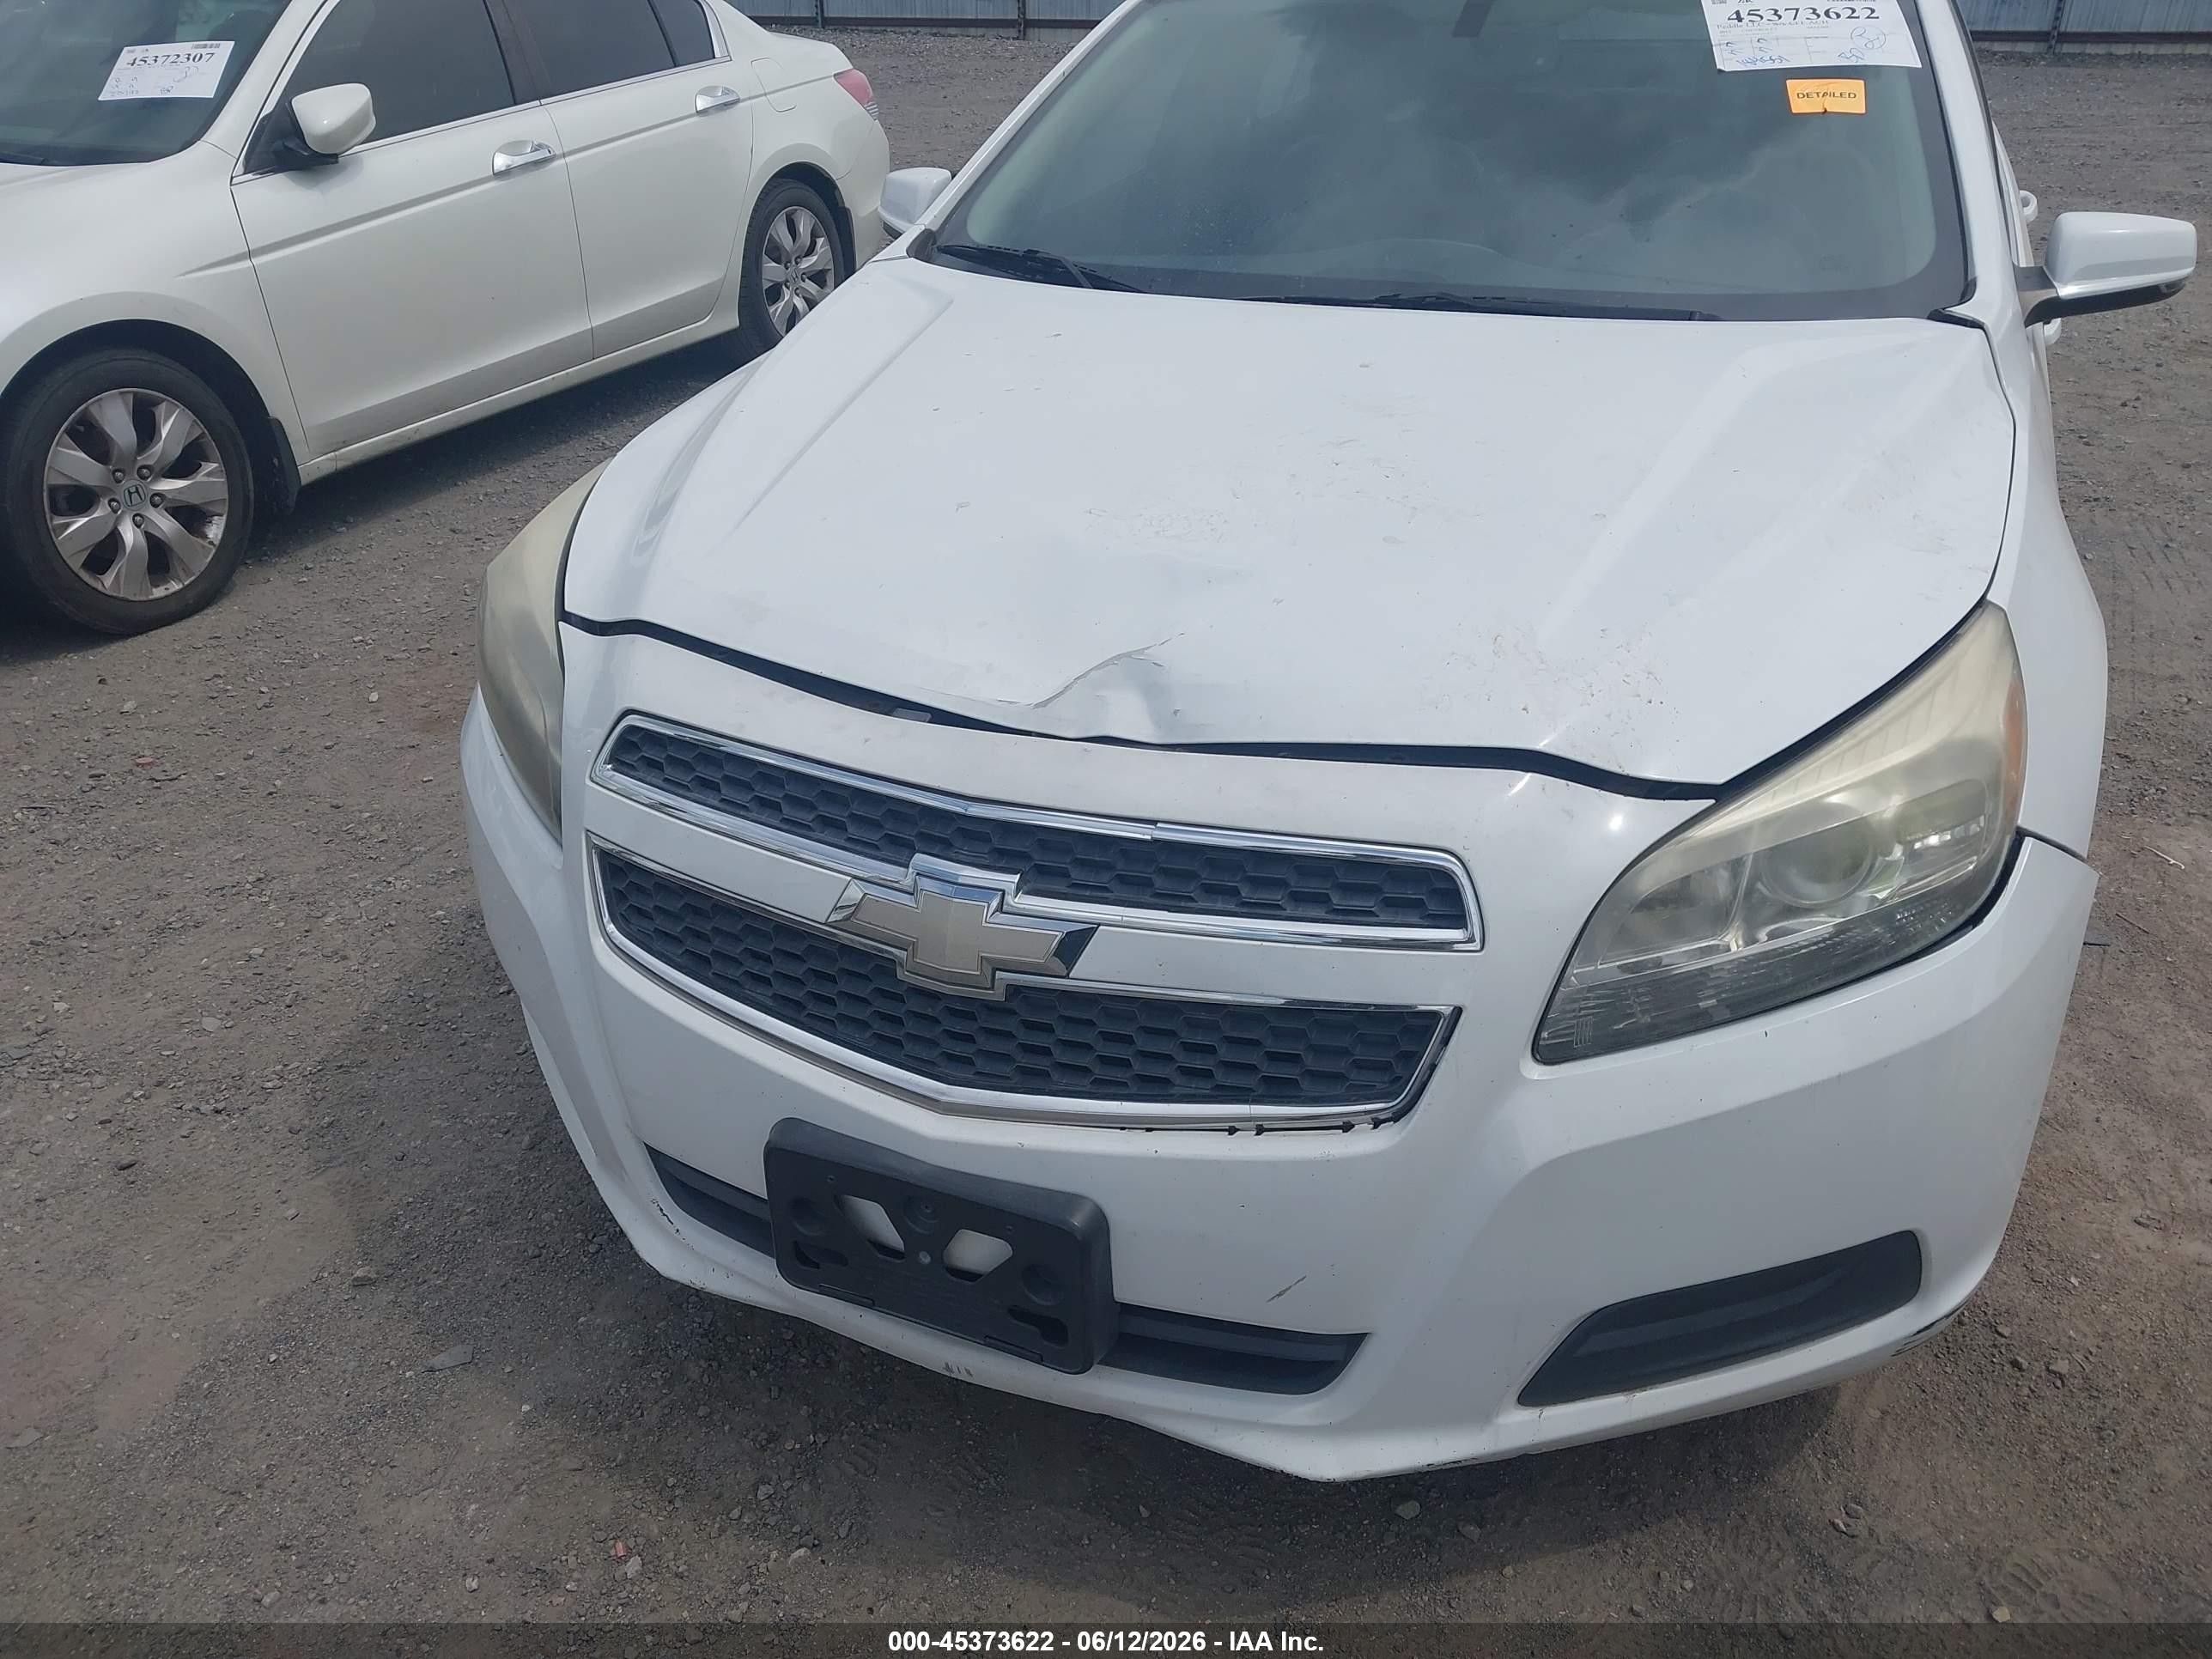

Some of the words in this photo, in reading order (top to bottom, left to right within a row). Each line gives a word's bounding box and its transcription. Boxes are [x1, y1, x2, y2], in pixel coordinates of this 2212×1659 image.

[1727, 6, 1880, 23] 45373622
[126, 52, 216, 67] 45372307
[1796, 91, 1857, 100] DETAILED
